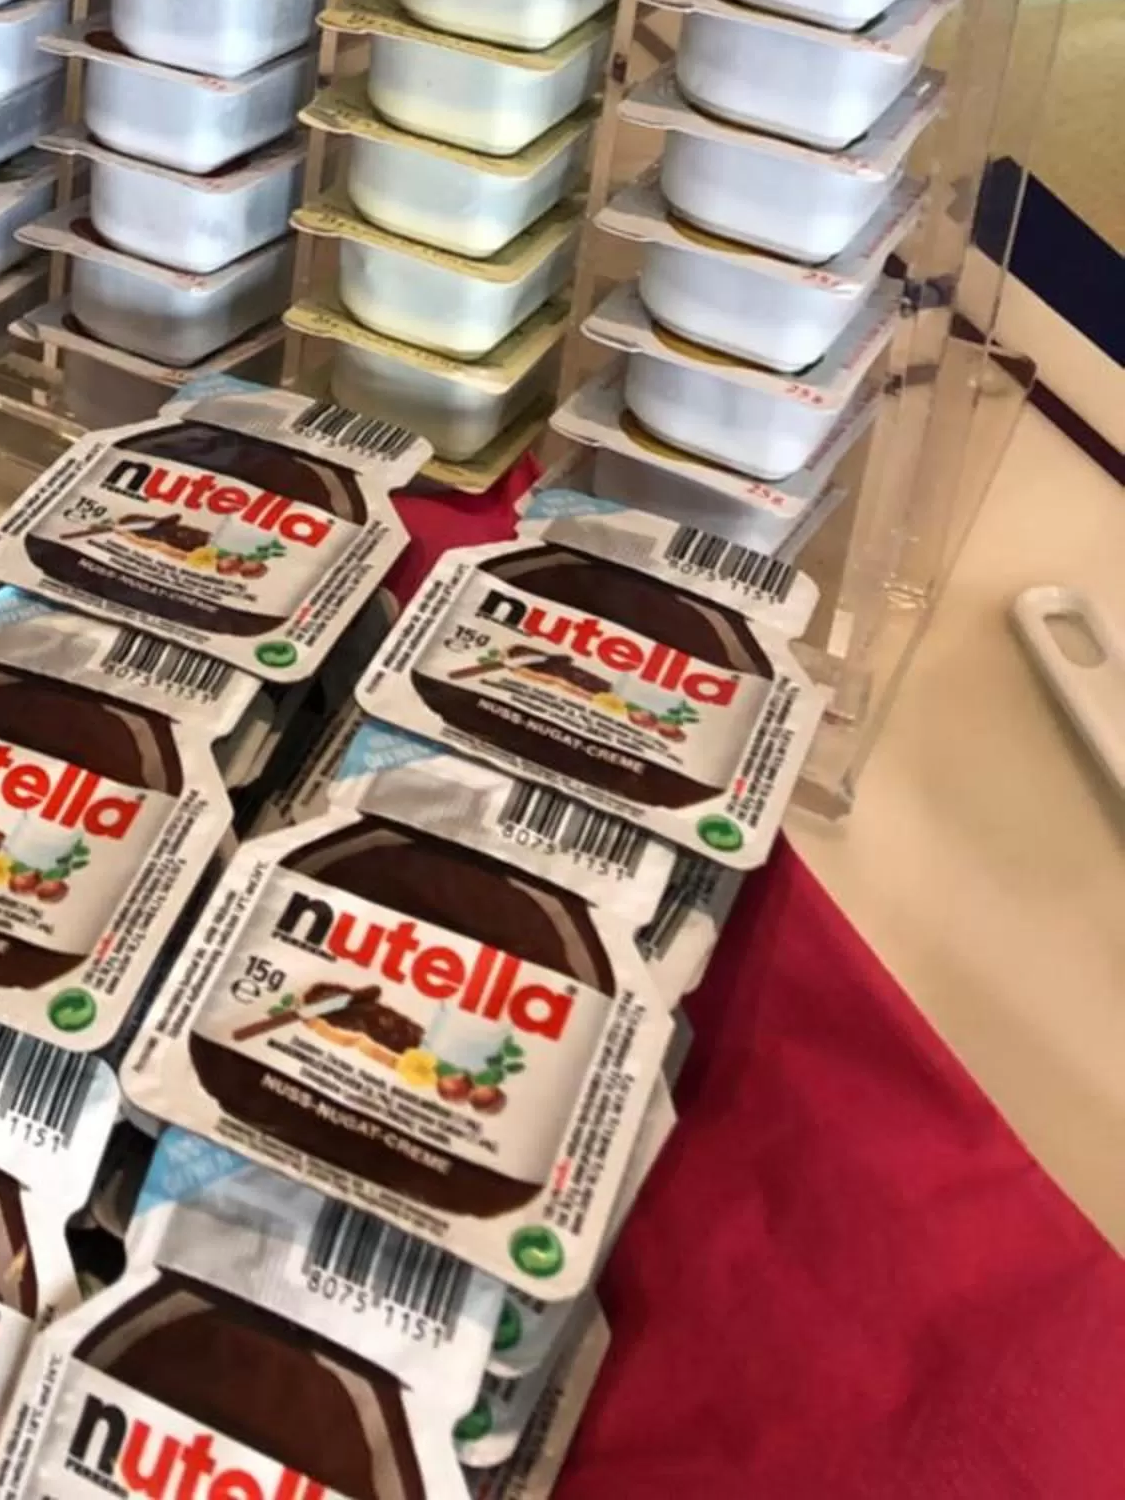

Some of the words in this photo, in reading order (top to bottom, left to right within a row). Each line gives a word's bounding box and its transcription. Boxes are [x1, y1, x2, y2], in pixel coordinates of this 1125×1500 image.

[104, 457, 335, 548] nutella
[479, 588, 742, 707] nutella
[477, 696, 649, 777] NUSS-NUGAT-CREME
[244, 953, 286, 993] 15g
[274, 891, 578, 1042] nutella
[8, 1116, 66, 1155] 1151
[261, 1072, 454, 1176] NUSS-NUGAT-CREME
[306, 1270, 371, 1315] 8075
[382, 1306, 446, 1350] 1151
